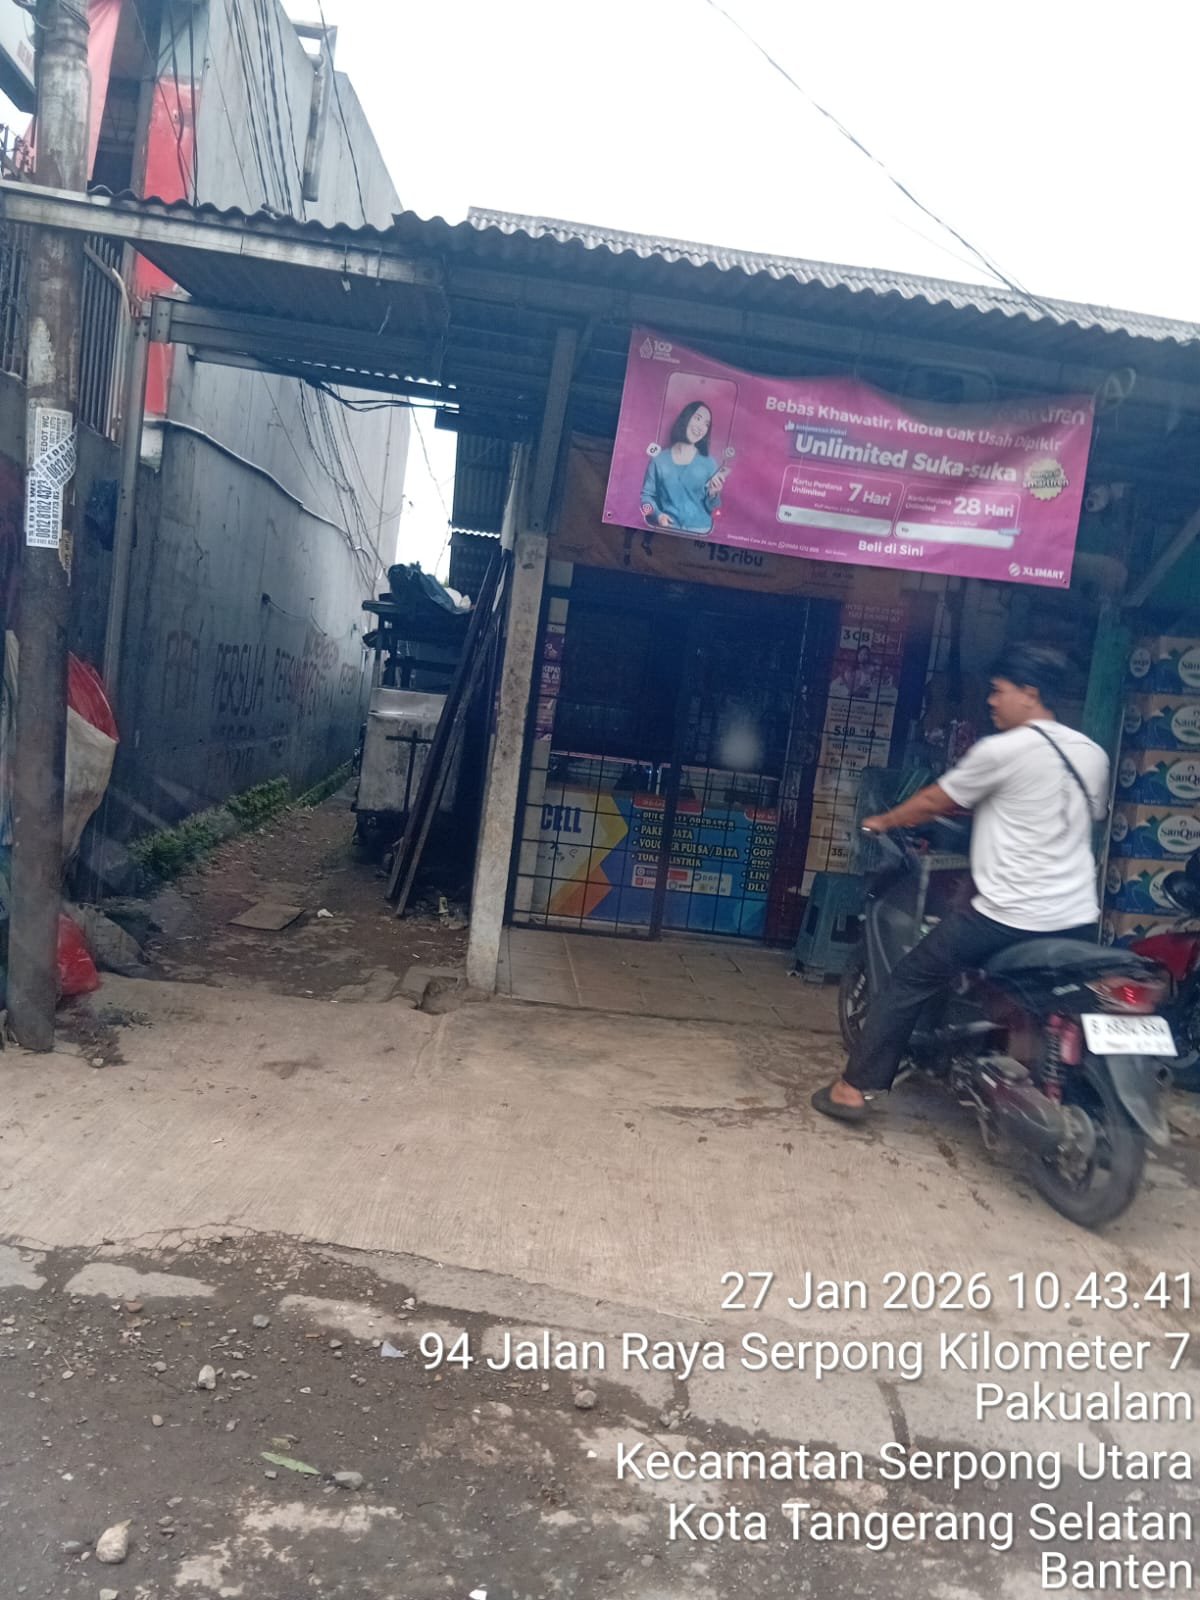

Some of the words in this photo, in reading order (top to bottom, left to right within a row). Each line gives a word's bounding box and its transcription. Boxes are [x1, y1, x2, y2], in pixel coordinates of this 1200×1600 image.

[765, 396, 815, 417] Bebas
[817, 404, 894, 431] Khawatir,
[946, 426, 975, 442] Gak
[977, 430, 1013, 448] Usah
[1014, 435, 1063, 452] Dipikir
[795, 433, 909, 469] Unlimited
[911, 452, 1018, 482] Suka-suka
[791, 486, 827, 498] Unlimited
[848, 482, 864, 502] 7
[862, 490, 893, 507] Hari
[36, 501, 51, 519] 8182
[953, 495, 982, 516] 28
[984, 503, 1015, 518] Hari
[36, 519, 51, 538] 0812
[857, 540, 883, 553] Beli
[884, 542, 898, 555] di
[899, 544, 925, 558] Sini
[540, 803, 582, 833] CELL
[640, 824, 663, 836] PAKE
[753, 836, 776, 846] DAN
[637, 852, 660, 864] TOKE
[752, 848, 774, 858] GOP
